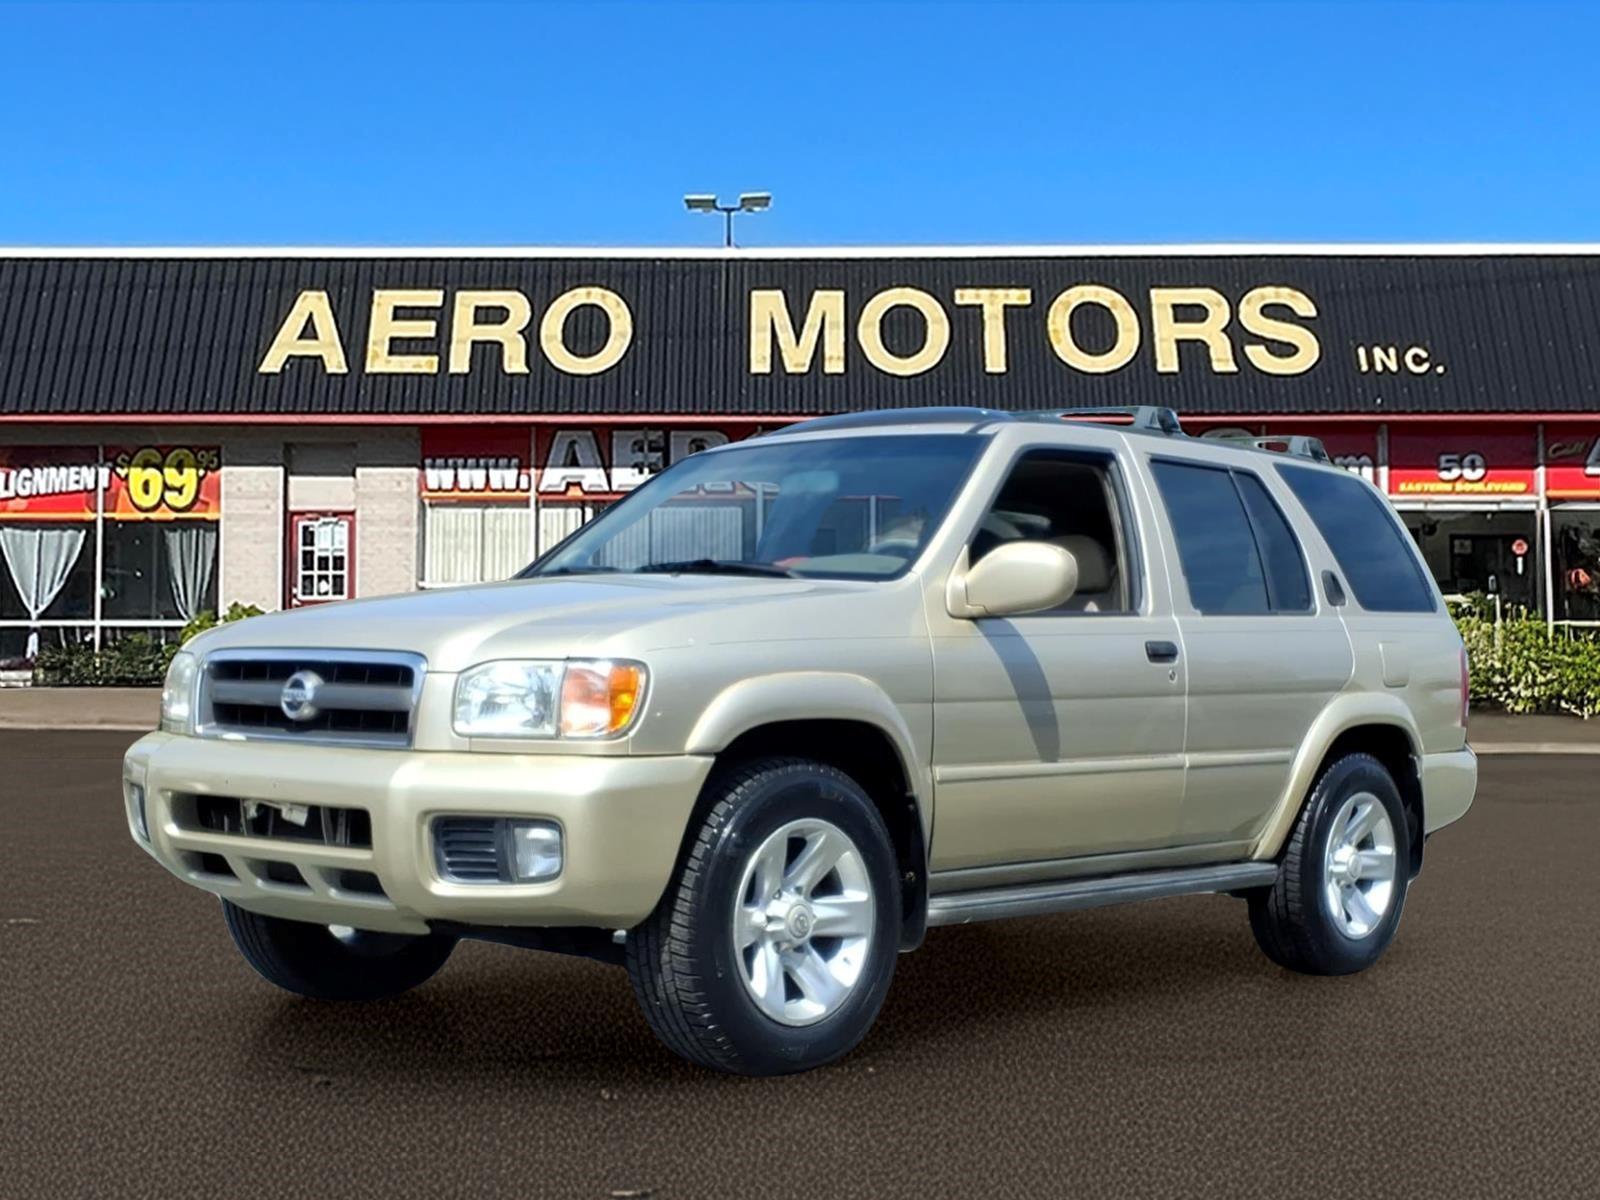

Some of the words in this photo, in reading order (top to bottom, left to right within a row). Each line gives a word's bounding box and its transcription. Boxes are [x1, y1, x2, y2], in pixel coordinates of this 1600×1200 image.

[258, 287, 633, 375] AERO
[750, 284, 1321, 377] MOTORS
[1357, 345, 1446, 374] INC.
[1438, 453, 1486, 481] 50
